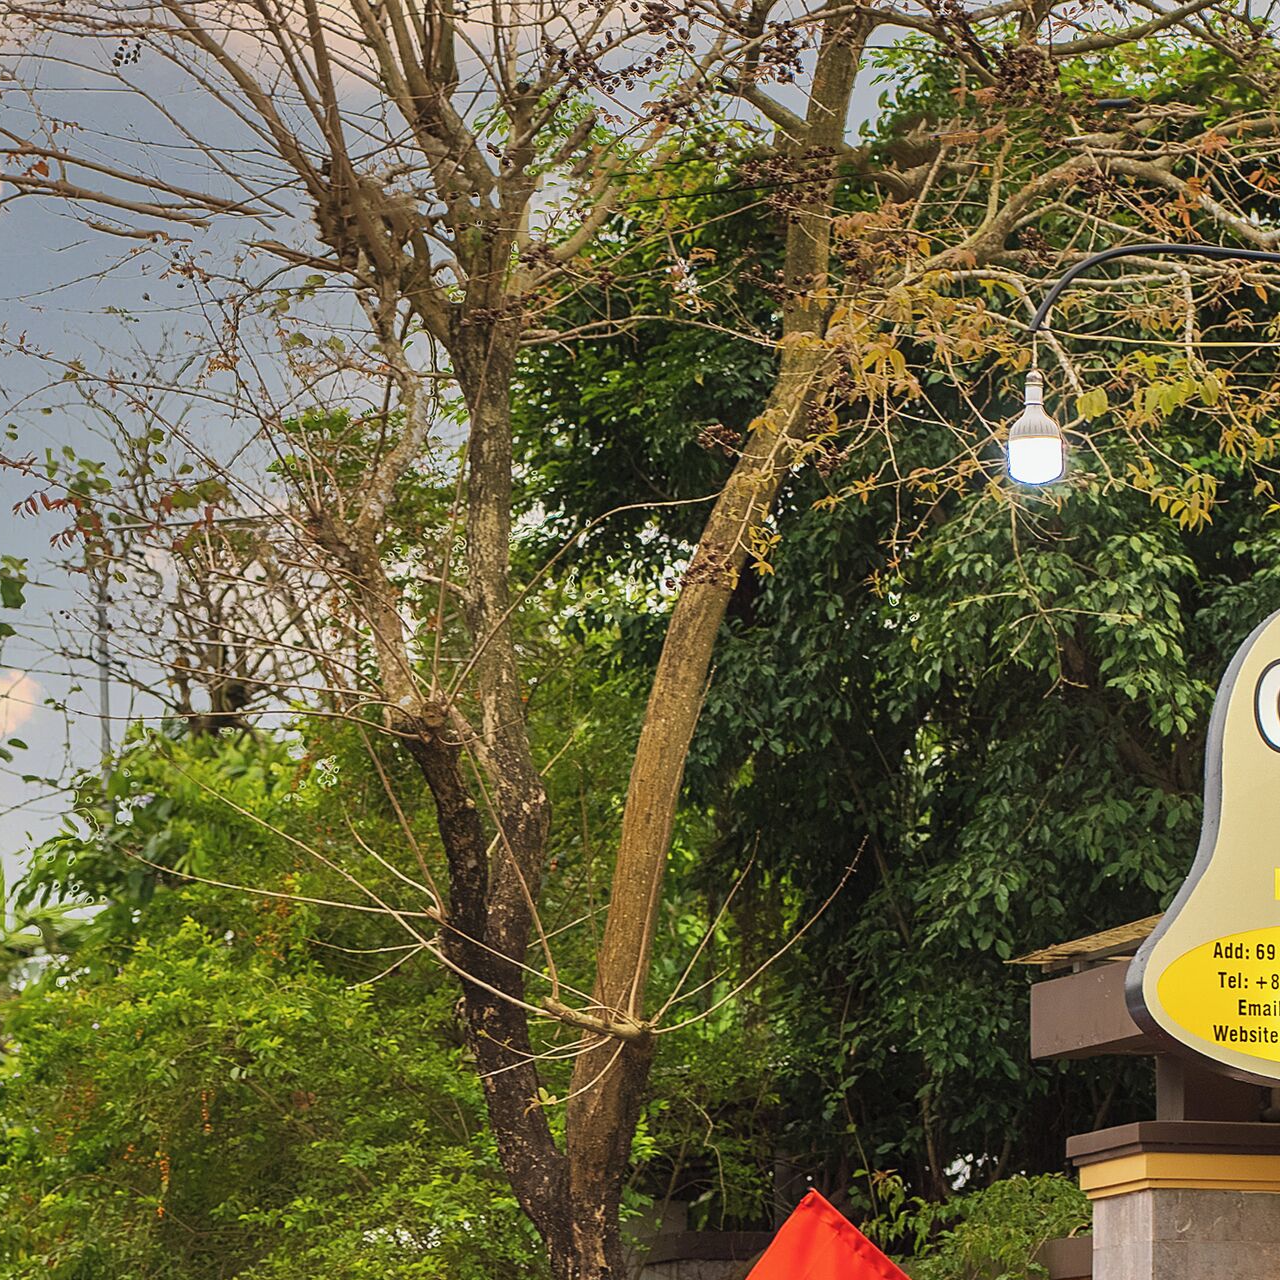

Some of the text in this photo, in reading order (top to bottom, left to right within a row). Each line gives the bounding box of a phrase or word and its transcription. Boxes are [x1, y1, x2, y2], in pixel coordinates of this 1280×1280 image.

[1213, 942, 1250, 960] Add:
[1256, 944, 1276, 960] 69
[1218, 971, 1249, 989] Tel:
